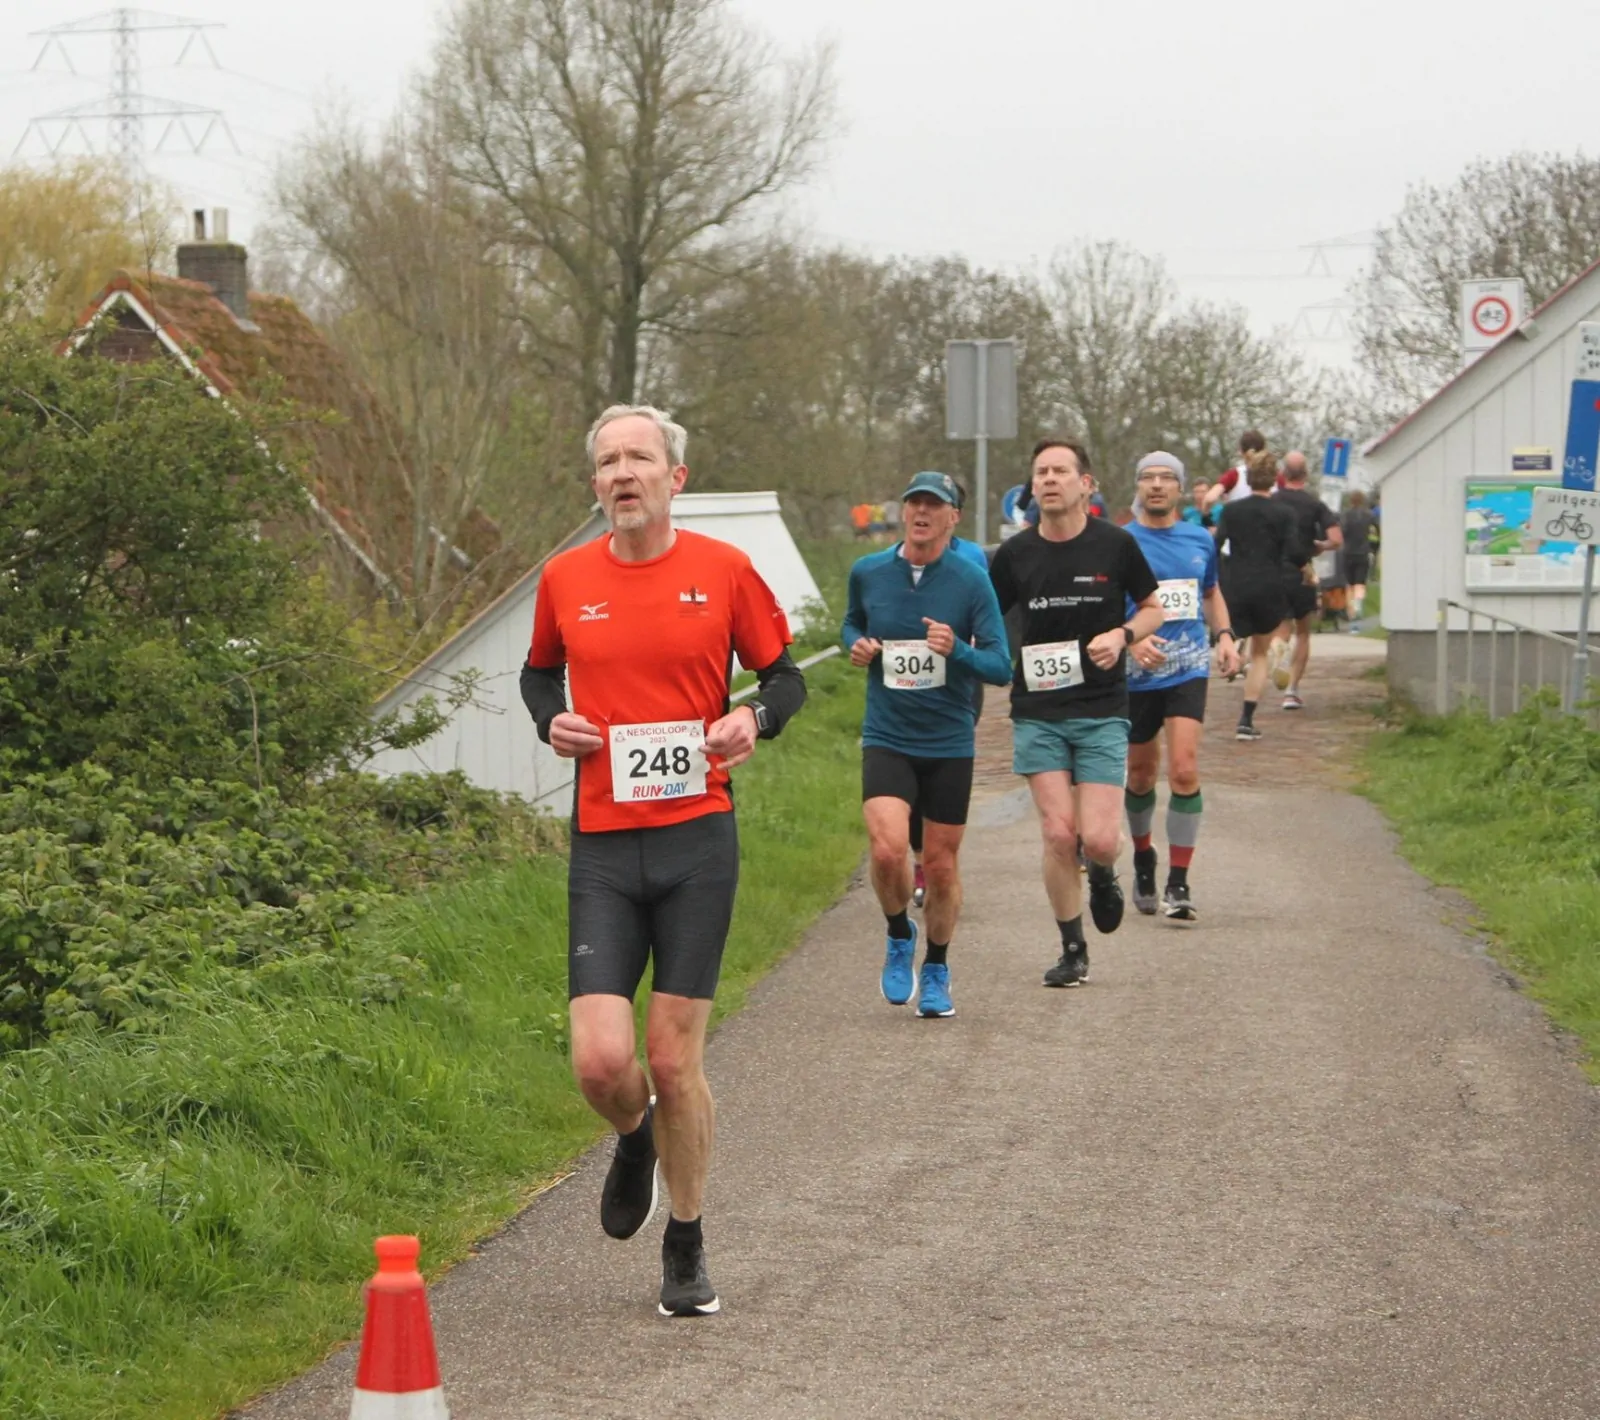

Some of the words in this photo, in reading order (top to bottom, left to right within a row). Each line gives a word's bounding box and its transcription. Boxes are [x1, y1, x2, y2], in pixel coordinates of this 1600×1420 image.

[1547, 493, 1600, 508] uitgez
[1160, 591, 1191, 608] 293
[894, 655, 935, 675] 304
[1034, 656, 1071, 677] 335
[626, 725, 687, 737] NESCIOLOOP
[628, 745, 691, 778] 248
